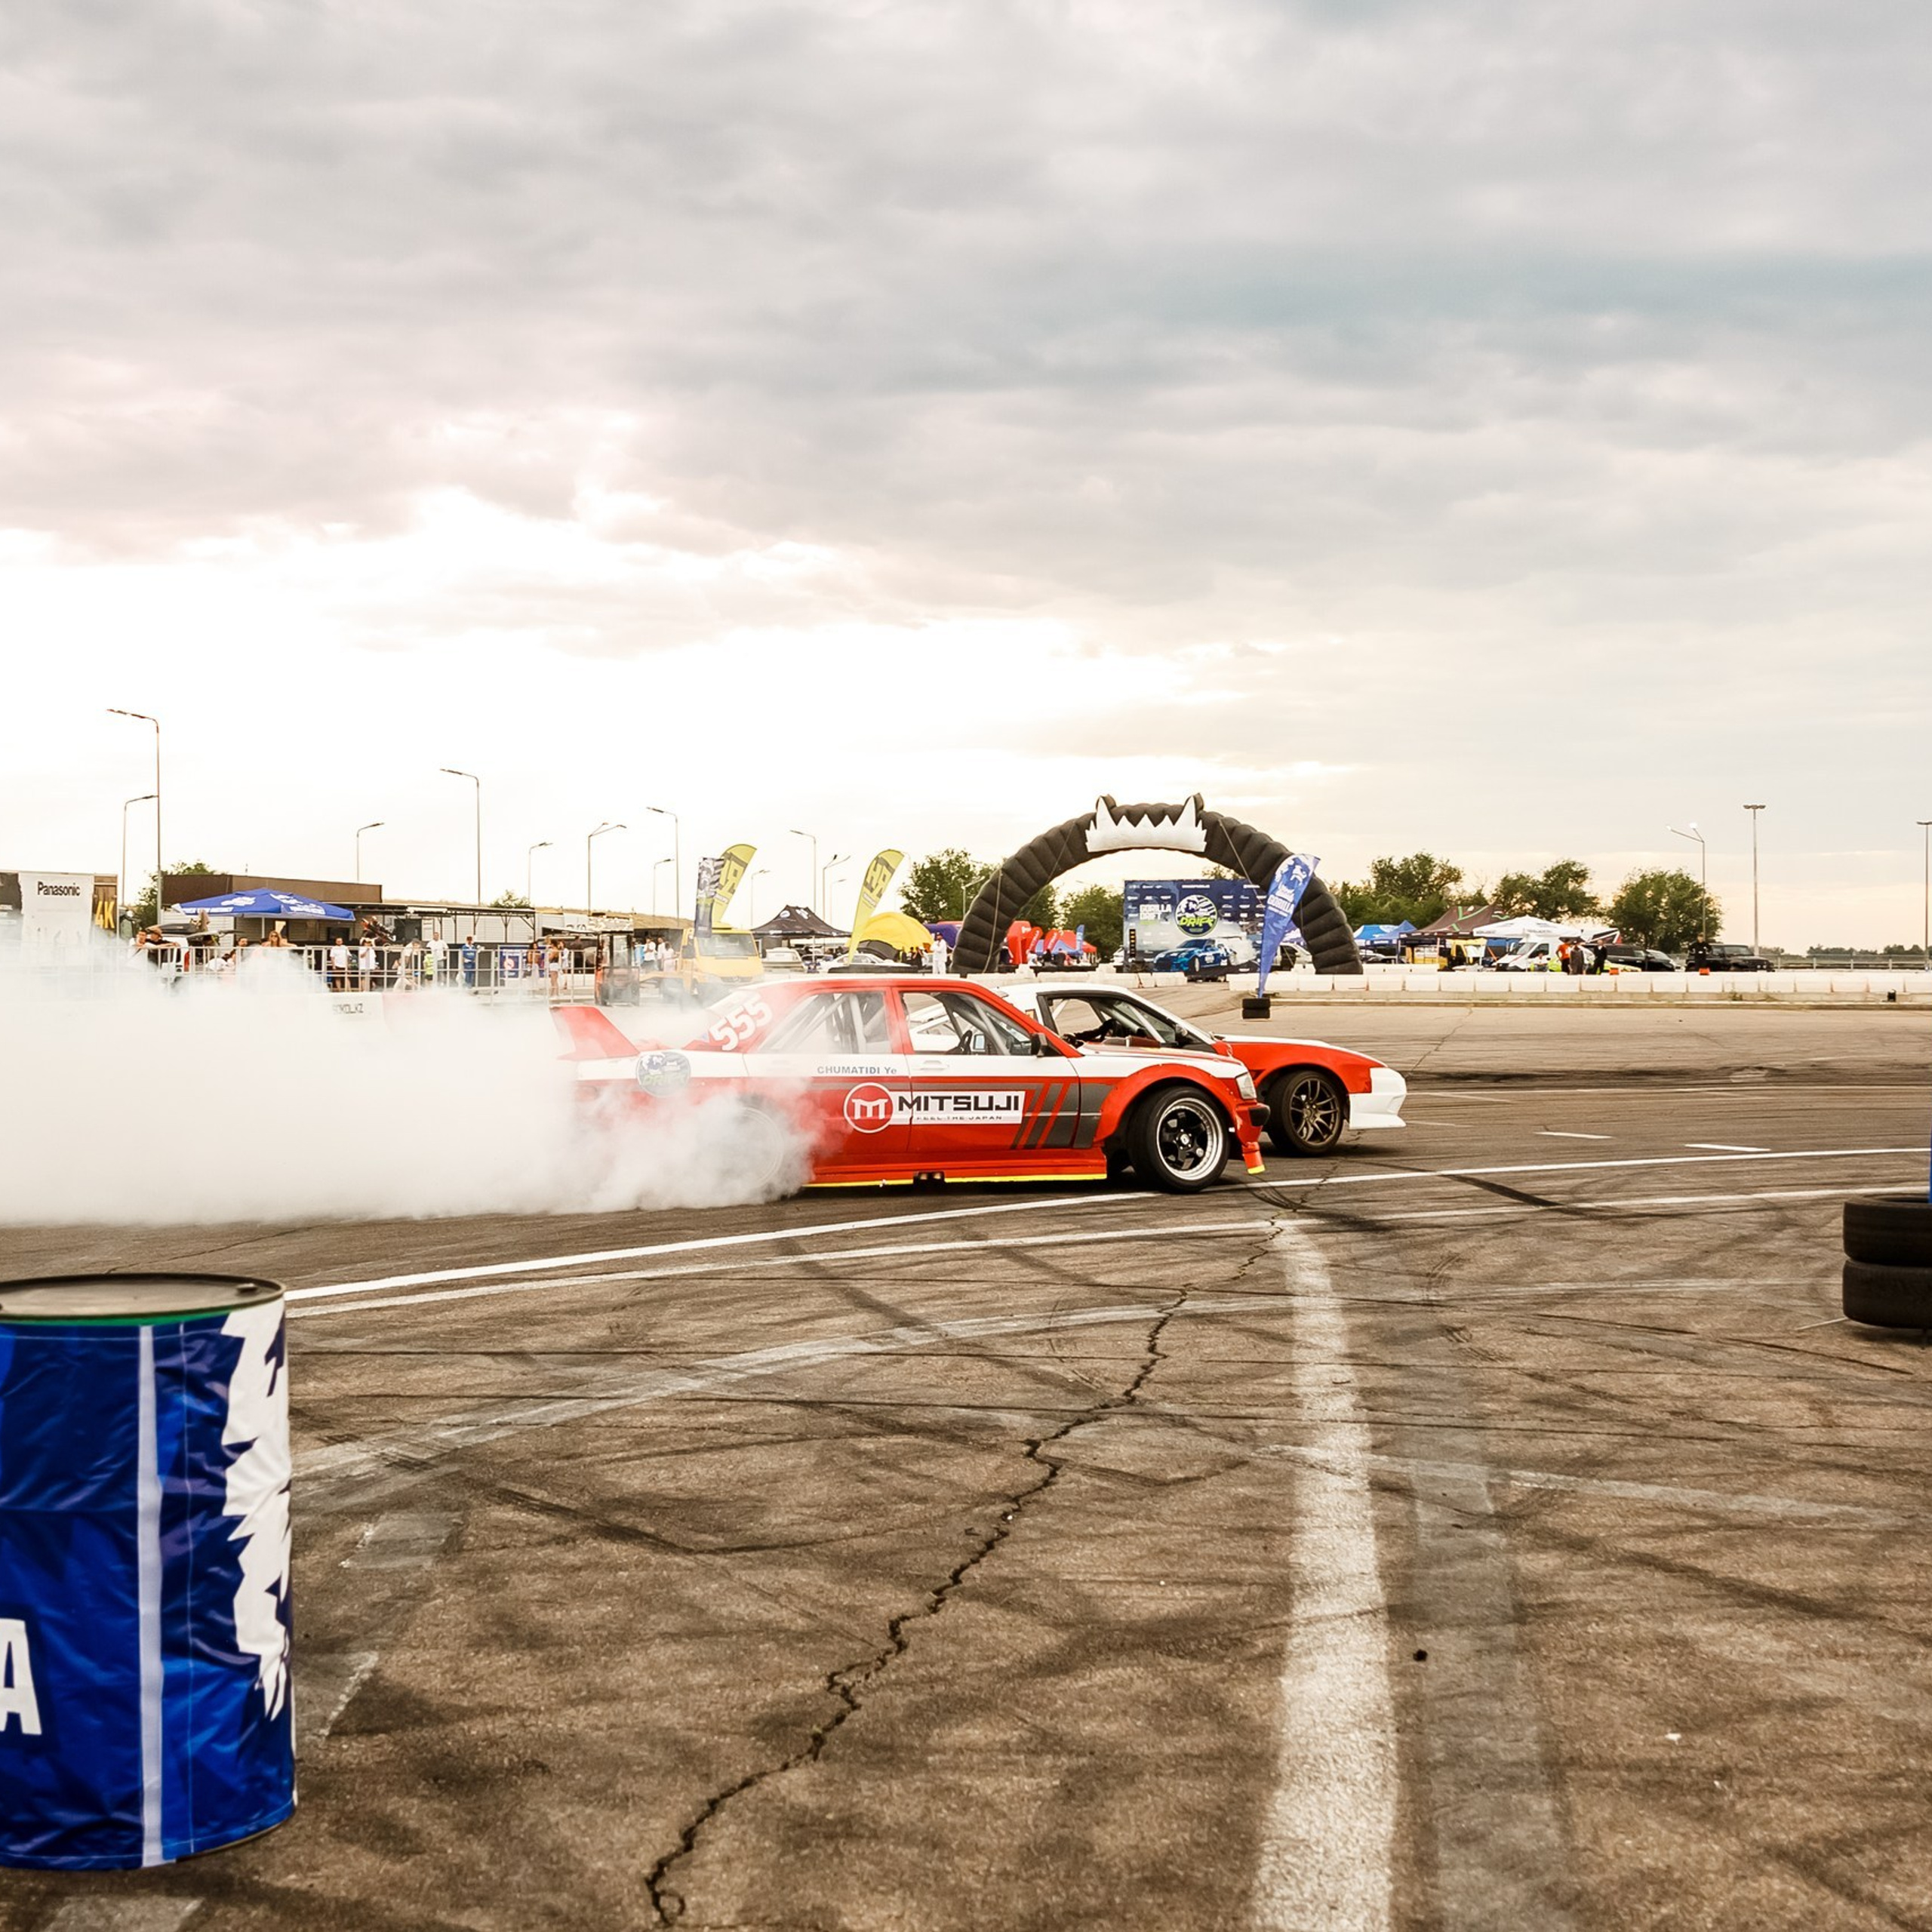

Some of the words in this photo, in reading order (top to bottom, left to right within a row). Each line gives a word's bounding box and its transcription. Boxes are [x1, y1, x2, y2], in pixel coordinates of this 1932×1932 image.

[37, 881, 81, 897] Panasonic
[94, 900, 115, 929] 4K
[709, 992, 772, 1051] 555
[817, 1066, 881, 1075] CHUMATIDI
[898, 1095, 1019, 1111] MITSUJI
